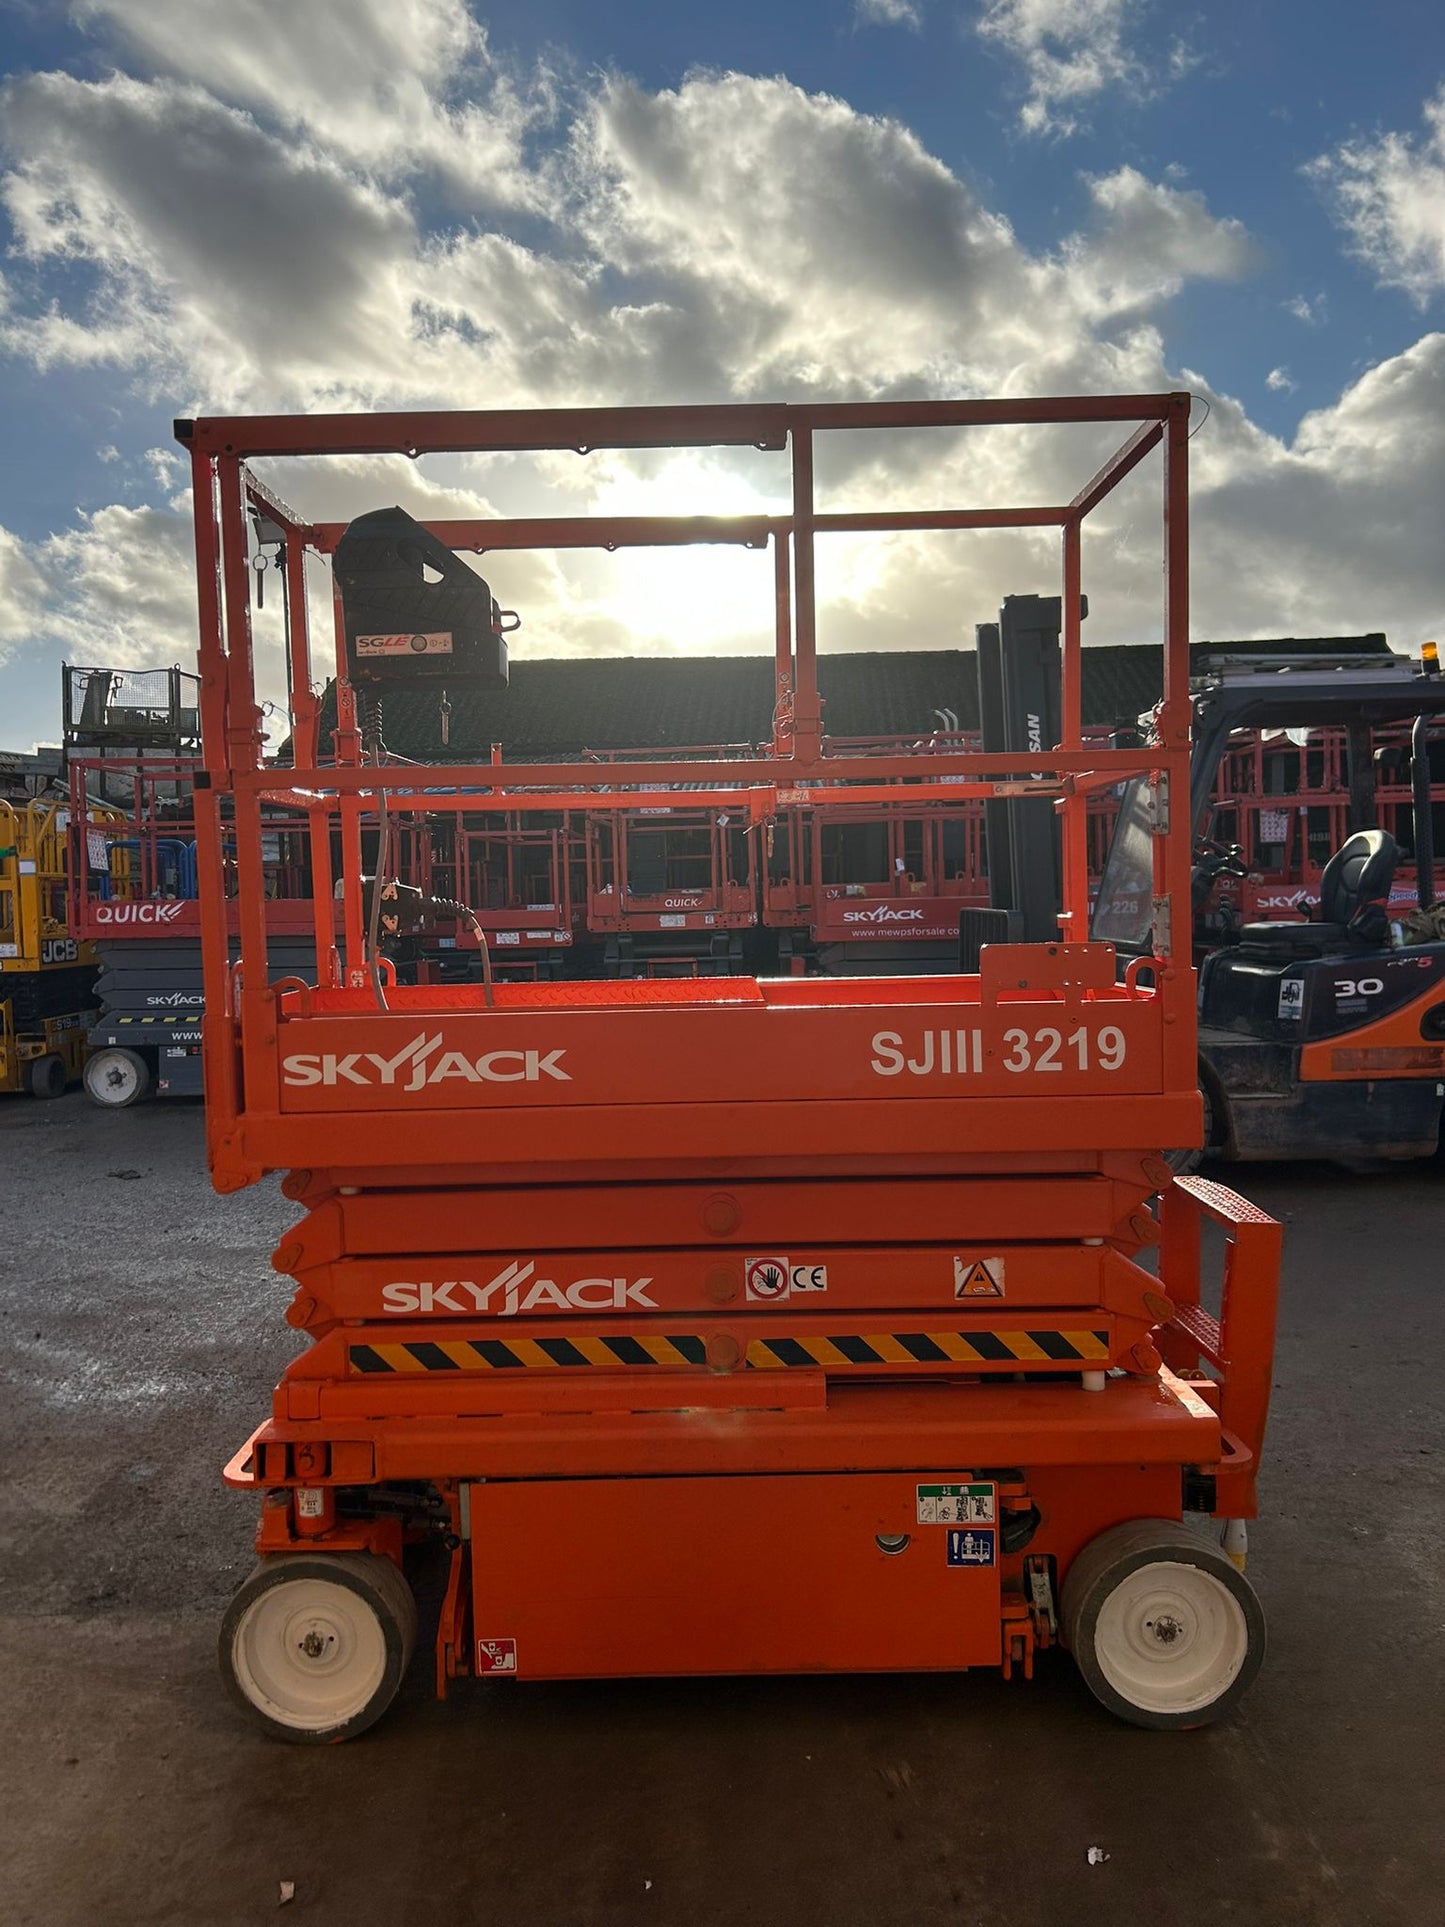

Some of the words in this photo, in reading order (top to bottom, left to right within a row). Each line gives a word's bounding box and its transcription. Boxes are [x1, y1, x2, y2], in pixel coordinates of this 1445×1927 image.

[96, 902, 178, 923] QUICK
[664, 898, 700, 908] QUICK
[843, 905, 924, 923] SKYJACK
[42, 939, 78, 963] JCB
[1334, 978, 1384, 997] 30
[282, 1031, 572, 1091] SKYJACK
[870, 1029, 983, 1076] SJIII
[1002, 1025, 1126, 1074] 3219
[382, 1260, 659, 1315] SKYJACK
[793, 1266, 825, 1289] CE
